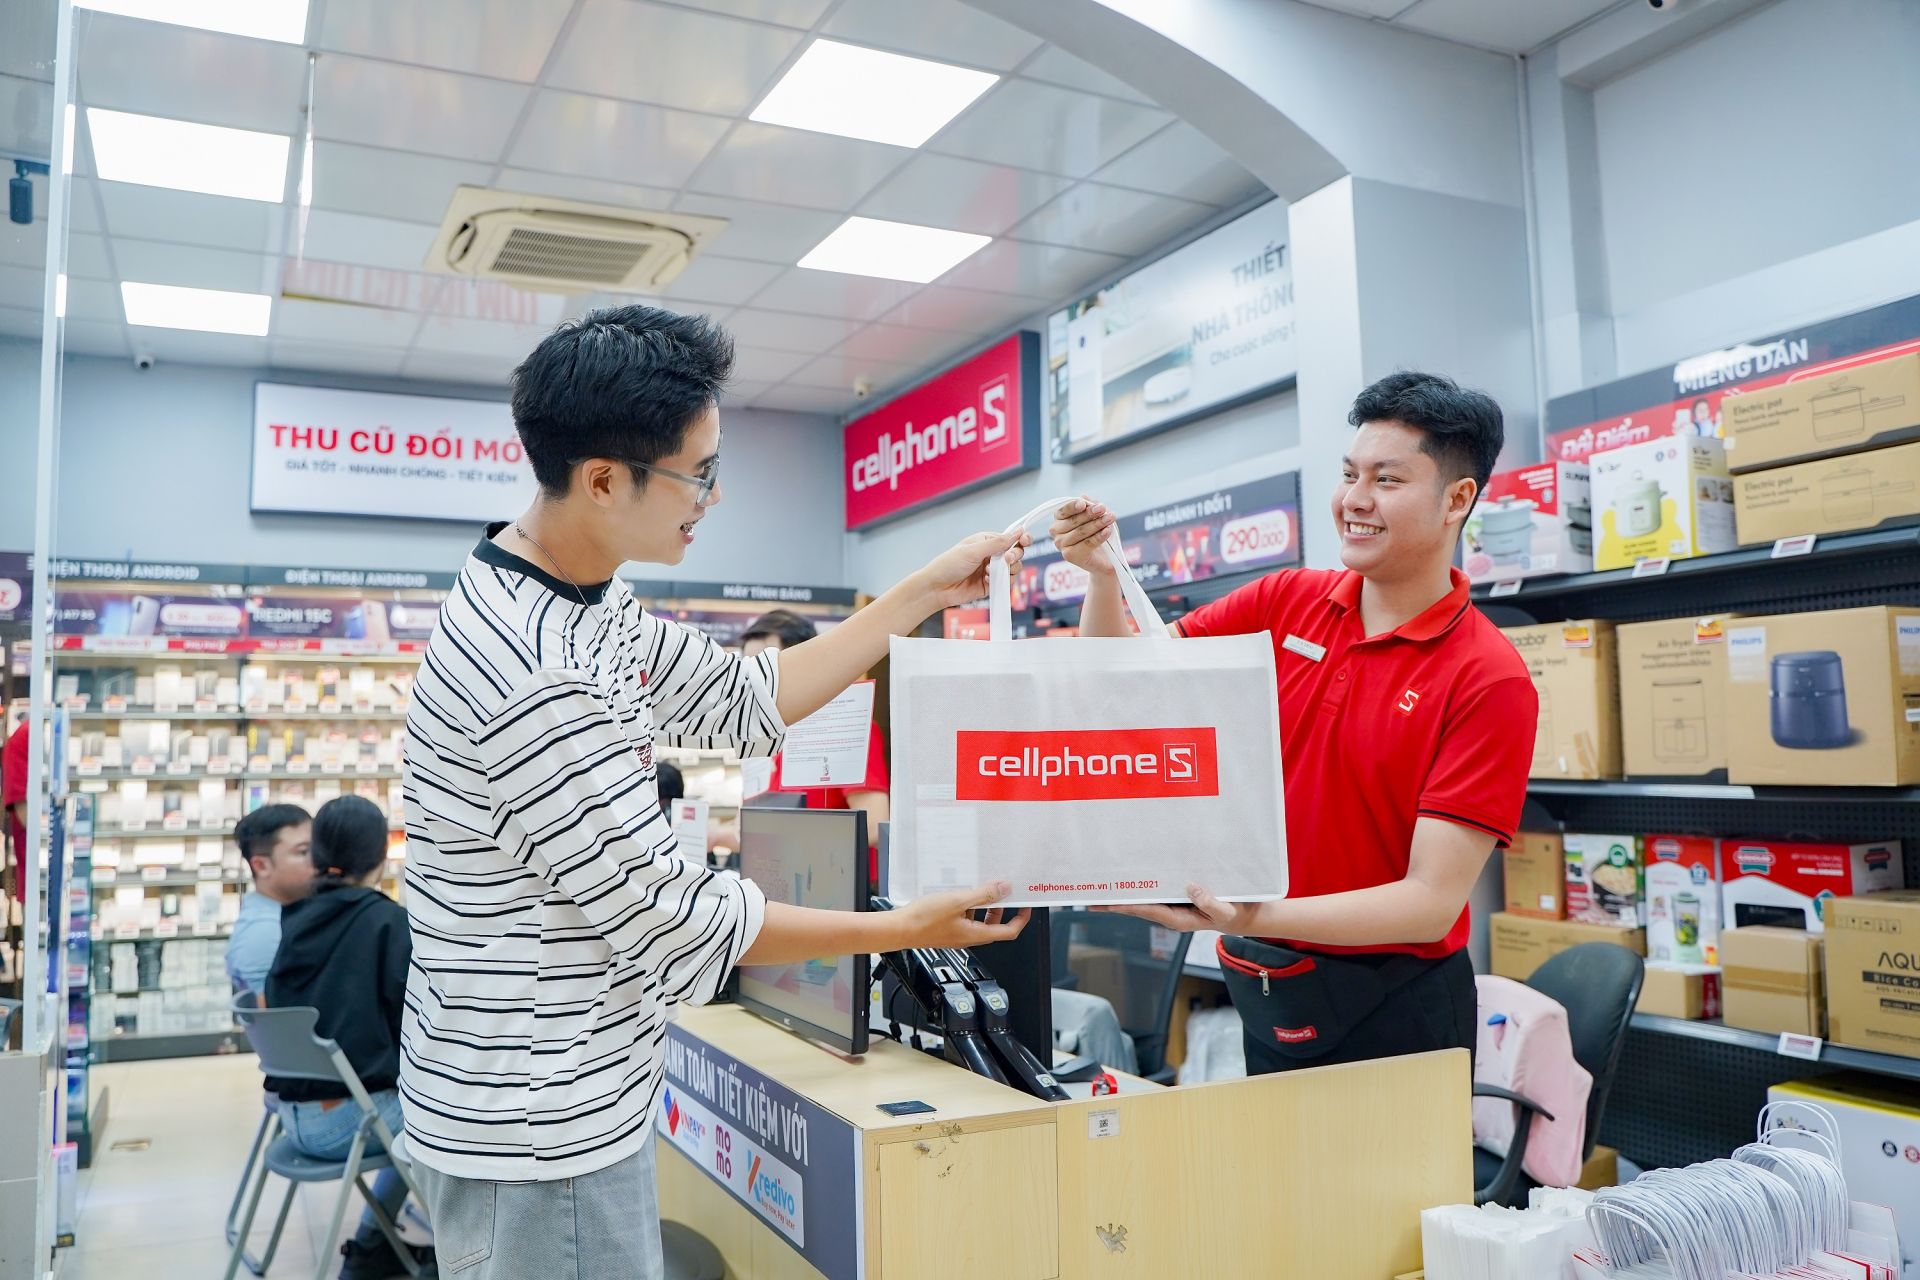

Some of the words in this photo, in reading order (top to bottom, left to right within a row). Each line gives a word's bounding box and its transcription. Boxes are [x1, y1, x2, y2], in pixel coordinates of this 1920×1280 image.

[1231, 240, 1286, 288] THIẾT
[269, 424, 339, 451] THU
[350, 425, 394, 455] CŨ
[406, 427, 462, 460] ĐỔI
[474, 433, 533, 465] MỚ
[83, 560, 129, 581] THOẠI
[132, 563, 200, 581] ANDROID
[1028, 883, 1108, 893] cellphones.com.vn
[1114, 880, 1159, 890] 1800.2021
[686, 1047, 715, 1103] TOÁN
[717, 1062, 742, 1121] TIẾT
[745, 1081, 779, 1147] KIỆM
[780, 1102, 809, 1167] VỚI
